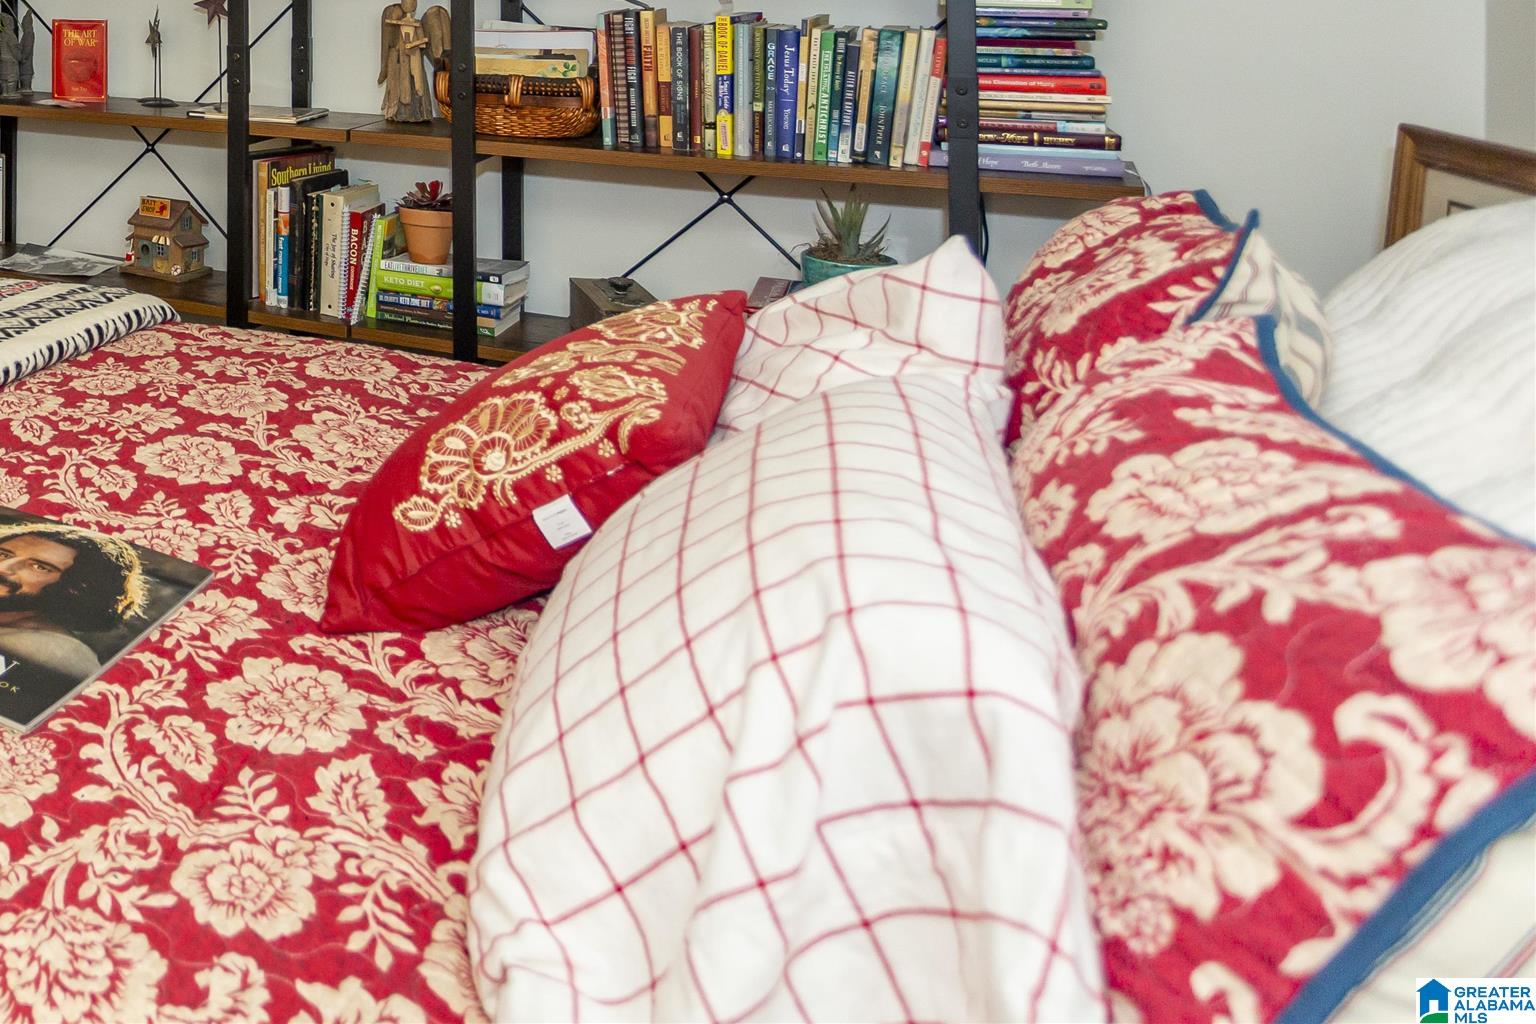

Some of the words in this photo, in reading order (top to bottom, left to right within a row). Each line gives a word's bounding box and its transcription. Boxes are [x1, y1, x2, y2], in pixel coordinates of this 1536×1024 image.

[64, 30, 80, 38] THE
[82, 30, 97, 38] ART
[624, 17, 635, 34] FIGHT
[718, 22, 728, 38] BOOK
[64, 38, 76, 46] OF
[76, 38, 97, 47] WAR
[718, 40, 728, 48] OF
[643, 44, 653, 72] FAITH
[718, 50, 728, 72] DANIEL
[767, 42, 775, 81] GRACE
[783, 44, 795, 67] Jesus
[627, 66, 637, 84] FIGHT
[676, 68, 683, 78] OF
[780, 68, 794, 96] Today
[846, 70, 855, 88] AFTER
[844, 90, 854, 99] THE
[818, 92, 828, 144] ANTICHRIST
[842, 102, 853, 126] RAPTURE
[878, 105, 887, 125] JOHN
[876, 125, 885, 144] PIPER
[271, 166, 308, 186] Southern
[350, 228, 358, 266] BACON
[384, 276, 404, 285] KETO
[407, 279, 425, 287] DIET
[400, 296, 410, 304] KETO
[420, 299, 430, 308] DIET
